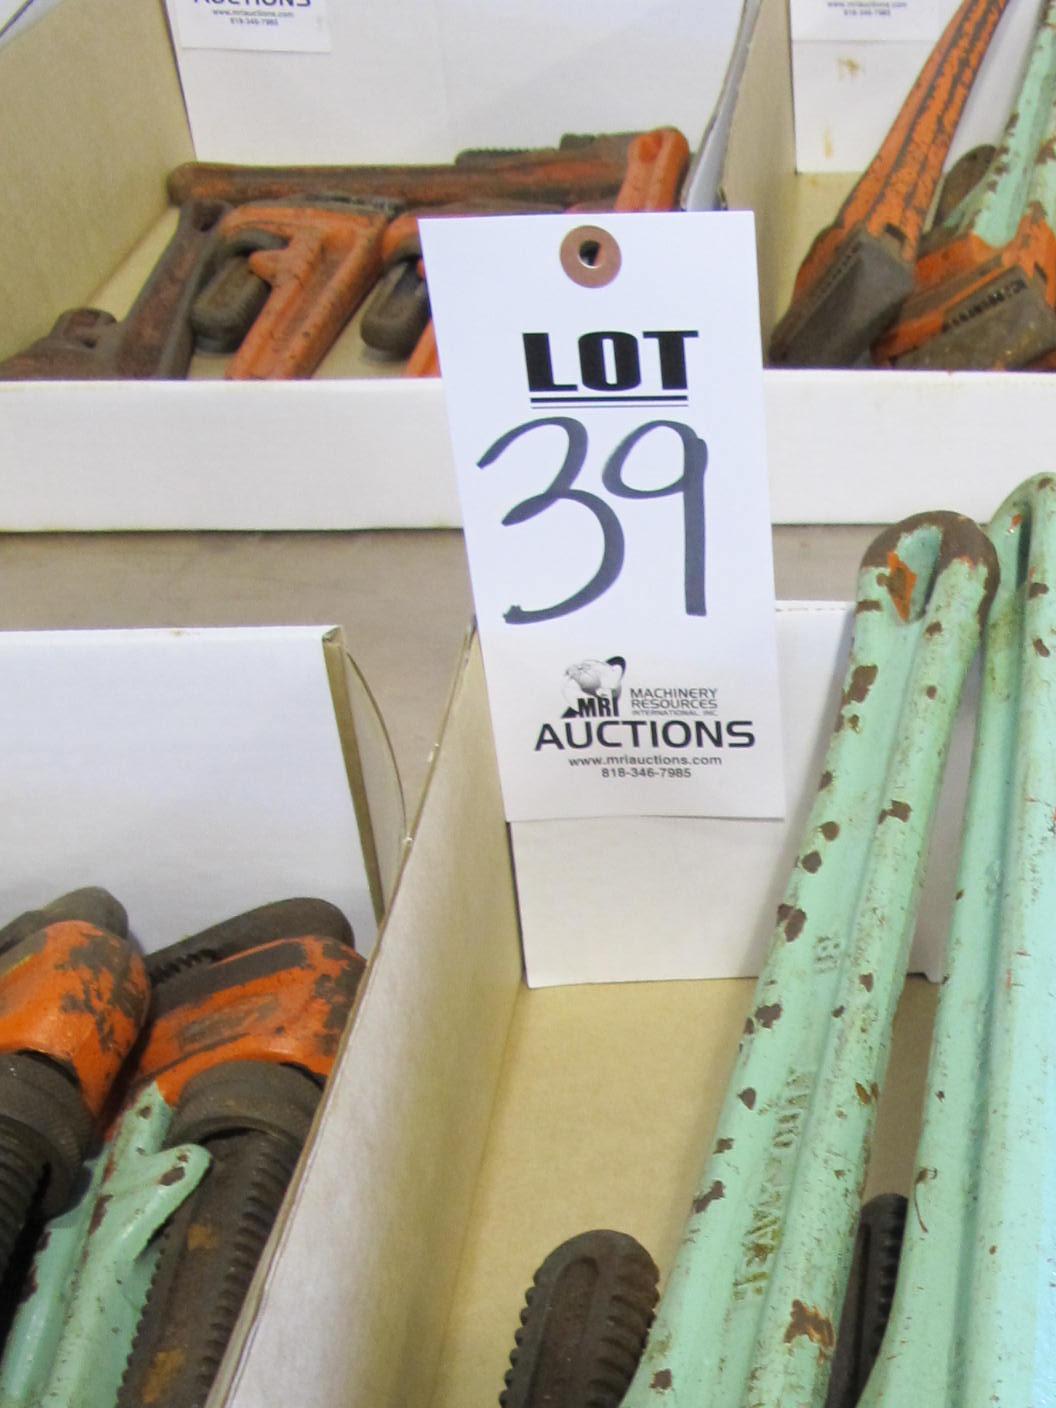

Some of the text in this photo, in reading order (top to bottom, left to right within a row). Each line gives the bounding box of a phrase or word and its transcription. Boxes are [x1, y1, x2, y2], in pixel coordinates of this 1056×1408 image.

[522, 330, 699, 392] LOT
[476, 416, 709, 625] 39
[630, 688, 718, 699] MACHINERY
[576, 696, 621, 718] MRI
[631, 699, 718, 709] RESOURCES
[534, 719, 757, 752] AUCTIONS
[568, 754, 723, 767] www.mriauctions.com
[601, 767, 692, 778] 818-346-7985
